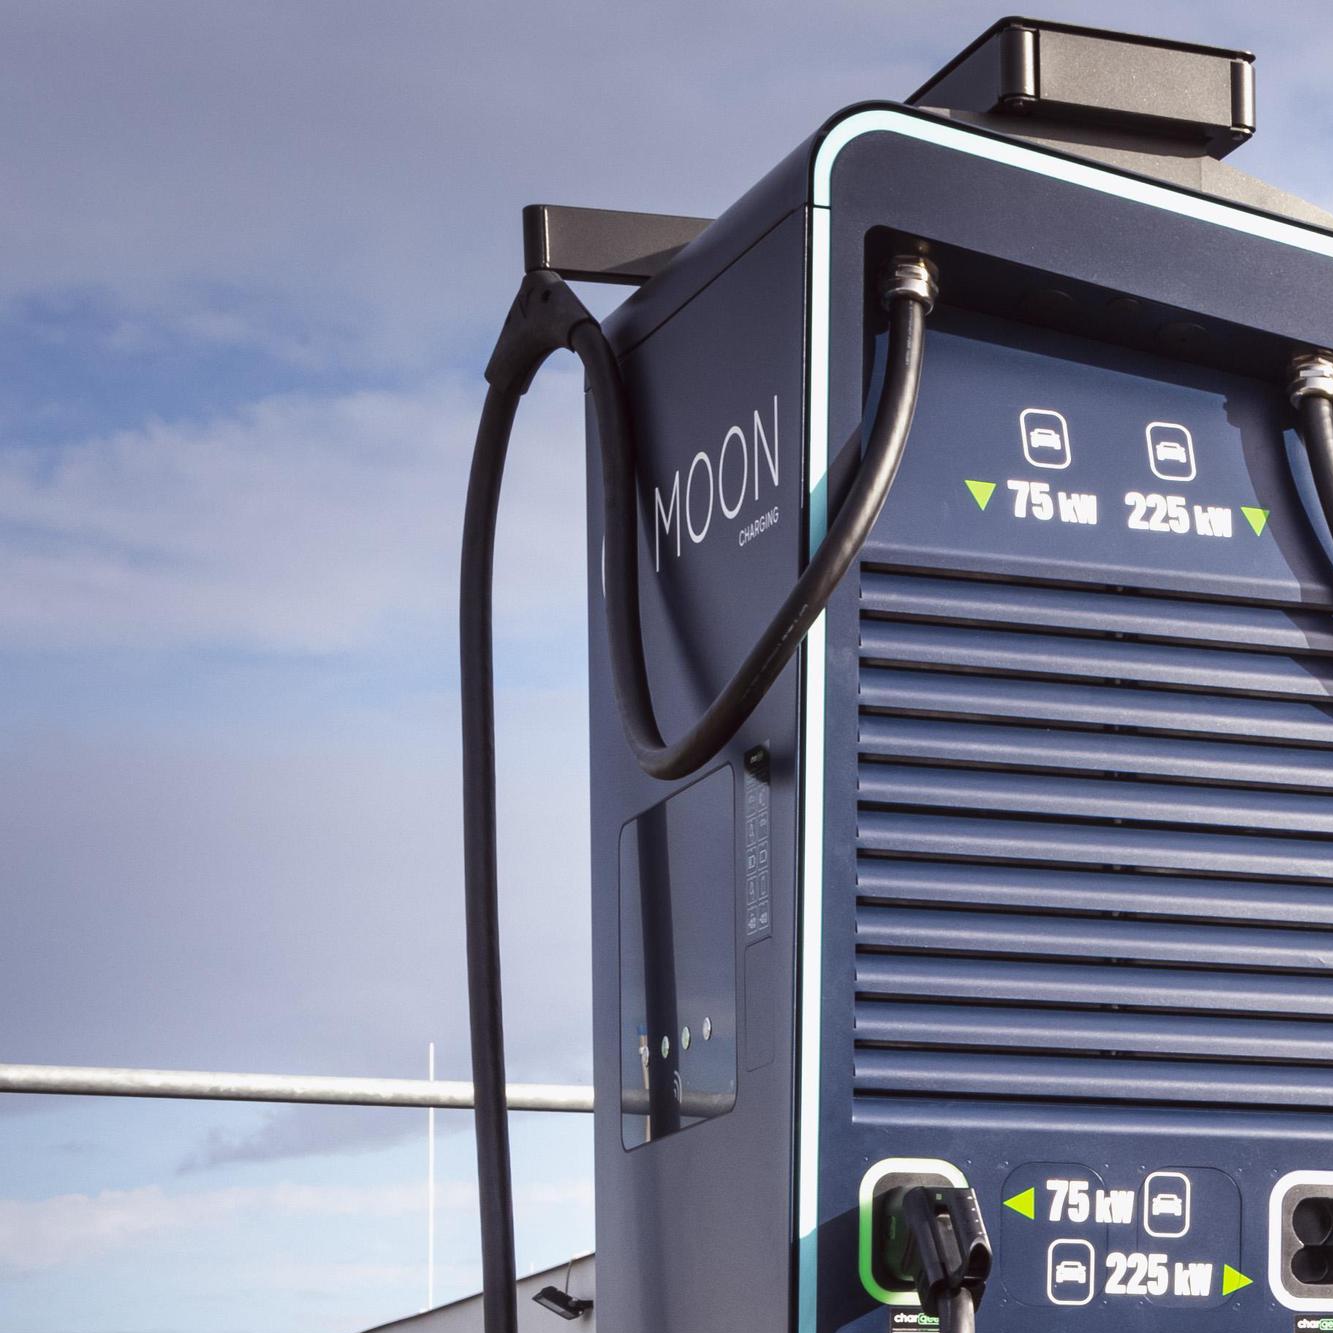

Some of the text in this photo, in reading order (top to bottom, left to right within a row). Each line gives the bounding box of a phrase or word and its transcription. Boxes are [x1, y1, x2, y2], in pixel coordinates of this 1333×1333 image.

[654, 394, 780, 573] MOON
[1006, 479, 1099, 526] 75 kW
[737, 506, 780, 547] CHARGING
[1124, 491, 1234, 538] 225 kW
[1046, 1179, 1135, 1224] 75 kW
[1104, 1251, 1213, 1297] 225 kW
